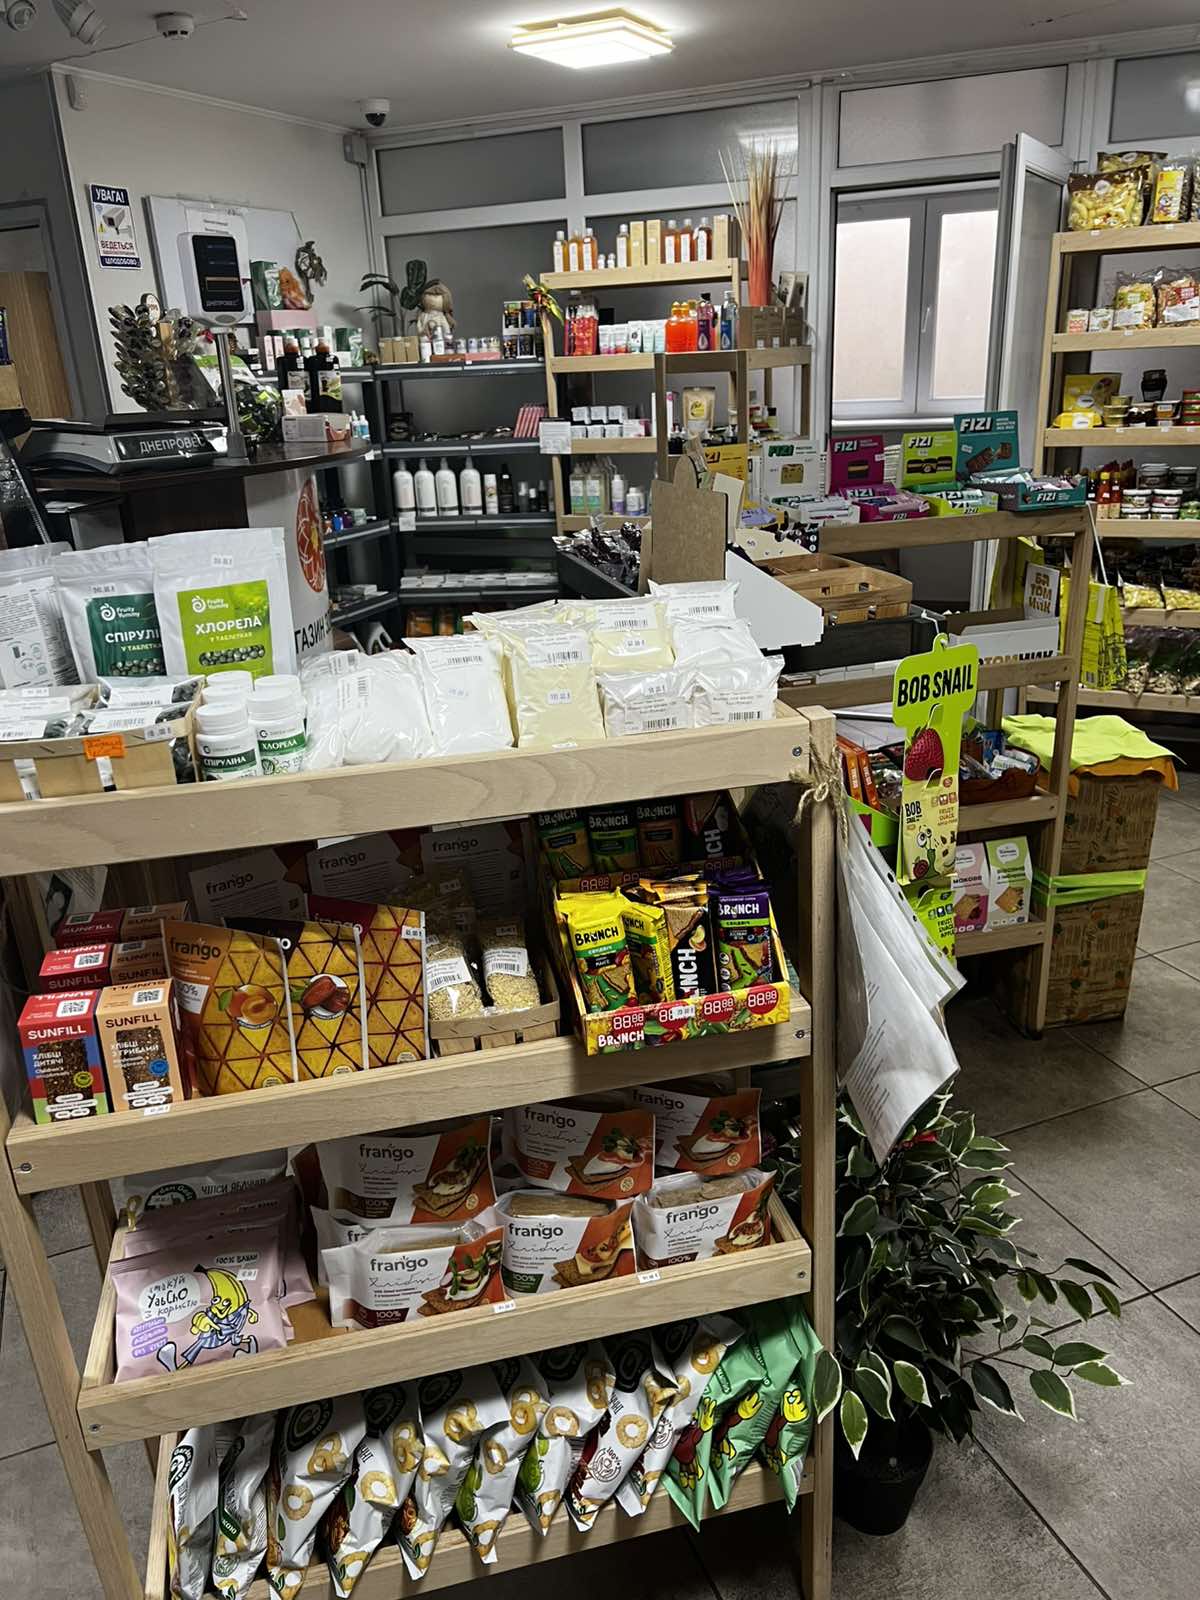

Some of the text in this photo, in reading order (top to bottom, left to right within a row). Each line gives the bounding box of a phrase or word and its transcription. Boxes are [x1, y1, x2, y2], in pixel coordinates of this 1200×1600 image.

[95, 188, 126, 203] УВАГА!
[961, 418, 993, 433] FIZI
[140, 437, 206, 455] ДНЕПРОВЕС
[834, 440, 857, 453] FIZI
[907, 434, 932, 448] FIZI
[1036, 492, 1056, 502] FIZI
[195, 615, 262, 635] ХЛОРЕЛА
[105, 628, 159, 644] СПІРУЛІ
[294, 616, 325, 654] ГАЗИН
[897, 664, 974, 707] BOB SNAIL
[262, 739, 297, 750] ХЛОРЕЛА
[204, 756, 247, 767] СПІРУЛІНА
[905, 800, 922, 816] BOB
[432, 837, 479, 853] frango
[318, 851, 367, 871] frango
[206, 872, 254, 895] frango
[575, 926, 620, 947] BRUNCH
[170, 937, 222, 961] frango
[49, 975, 103, 990] SUNFILL
[105, 1012, 162, 1029] SUNFILL
[27, 1024, 87, 1041] SUNFILL
[597, 1029, 645, 1049] BRUNCH
[633, 1089, 685, 1111] frango
[524, 1106, 577, 1130] frango
[359, 1144, 414, 1162] frango
[665, 1204, 720, 1225] frango
[508, 1223, 564, 1240] frango
[370, 1256, 429, 1275] frango
